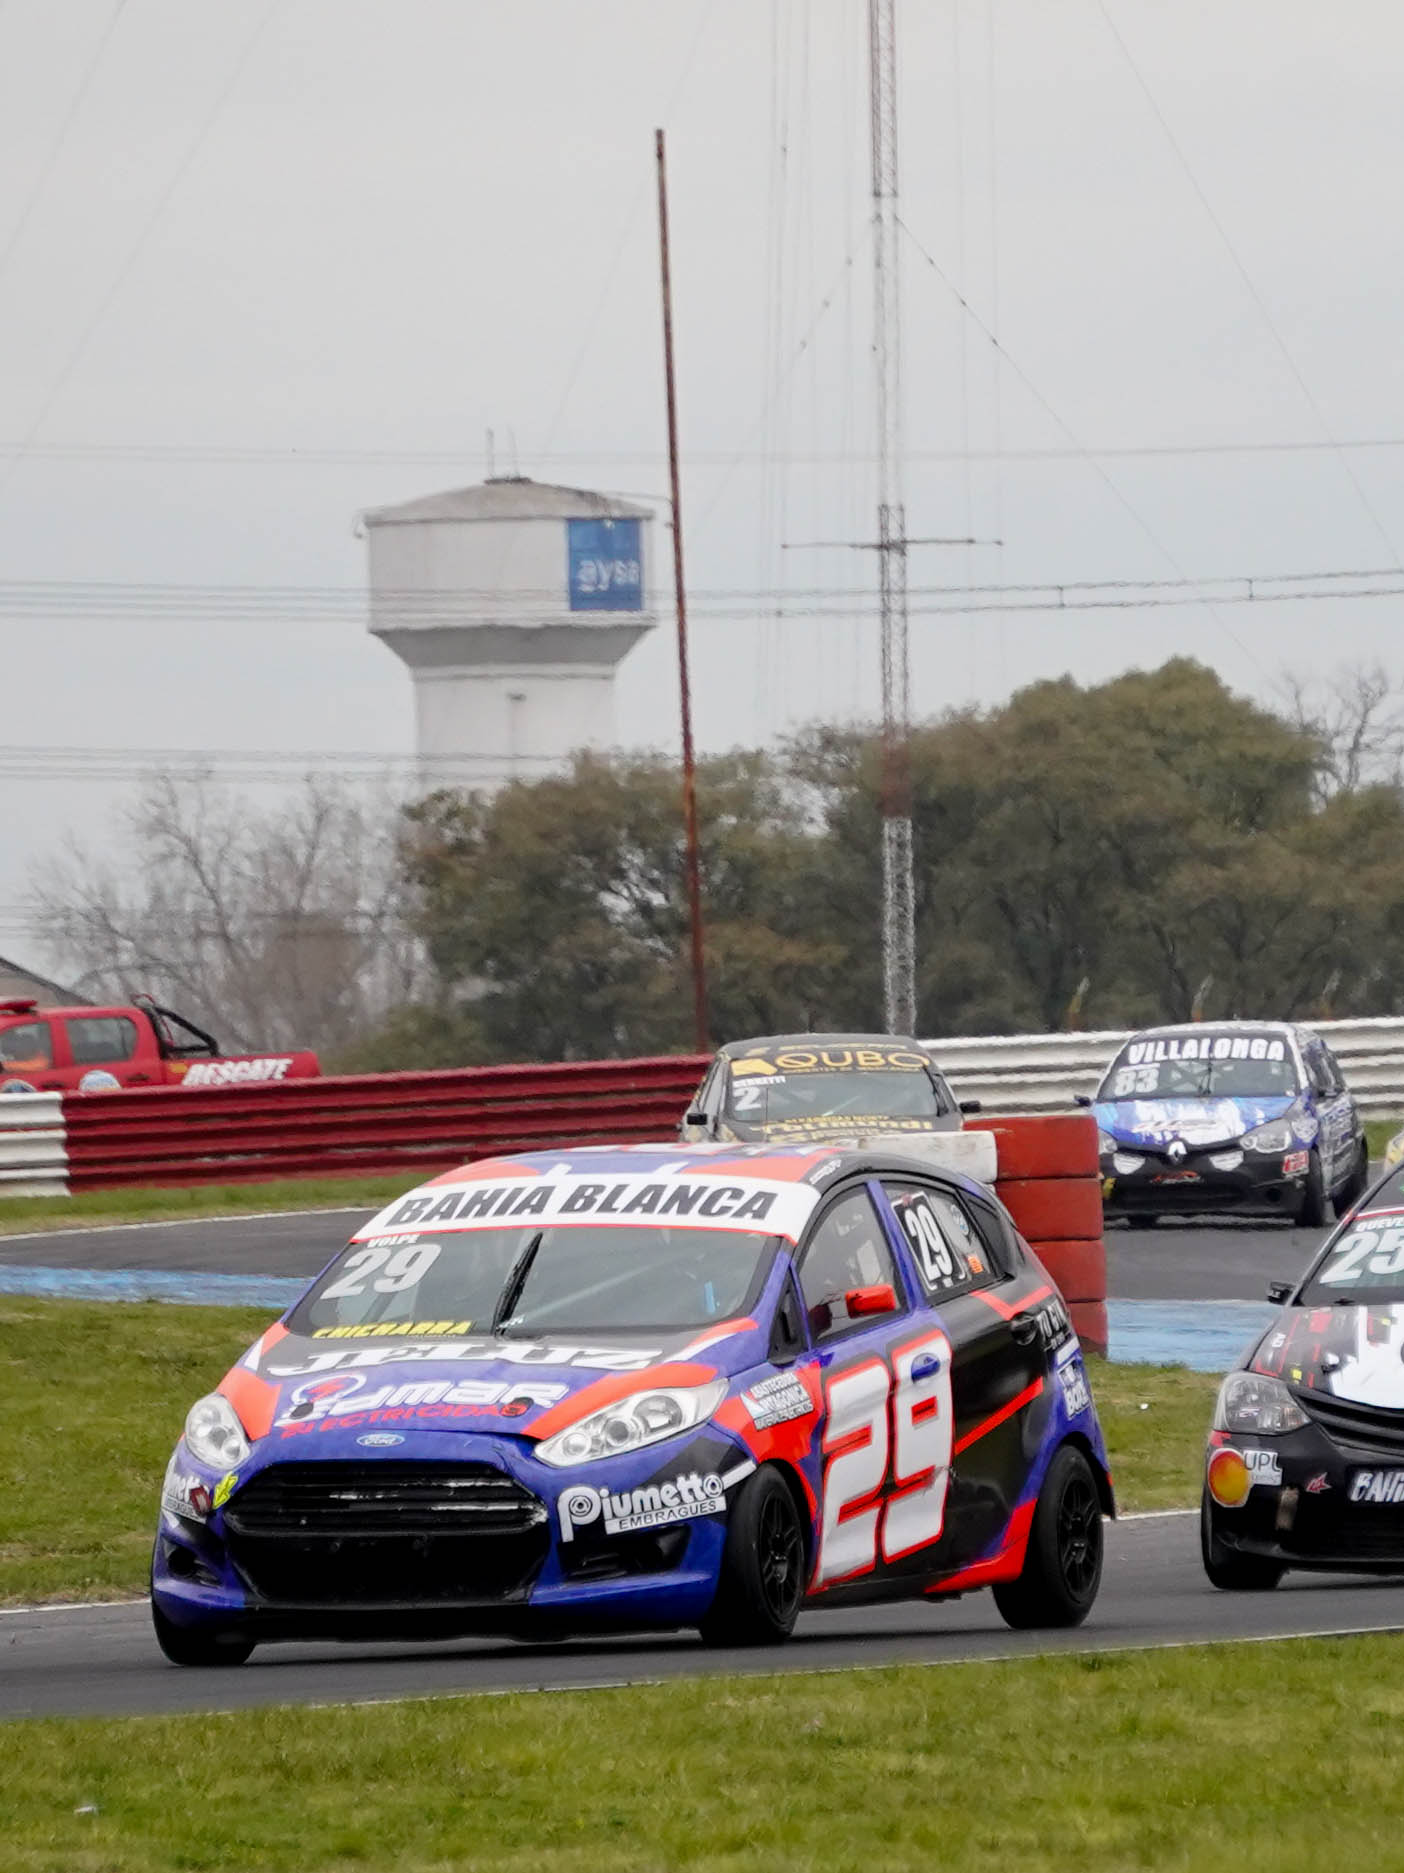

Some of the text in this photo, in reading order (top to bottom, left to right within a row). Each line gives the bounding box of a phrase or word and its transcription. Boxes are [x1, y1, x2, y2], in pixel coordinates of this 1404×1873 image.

[774, 1050, 930, 1070] QUBO
[1128, 1038, 1286, 1065] VILLALONGA
[734, 1086, 762, 1111] 2
[384, 1183, 778, 1227] BAHIA BLANCA
[366, 1234, 421, 1249] VOLPE
[904, 1203, 953, 1282] 29
[320, 1243, 442, 1300] 29
[266, 1342, 664, 1377] JELUZ
[813, 1329, 954, 1592] 29
[1243, 1452, 1281, 1472] UPL
[618, 1500, 718, 1531] EMBRAGUES
